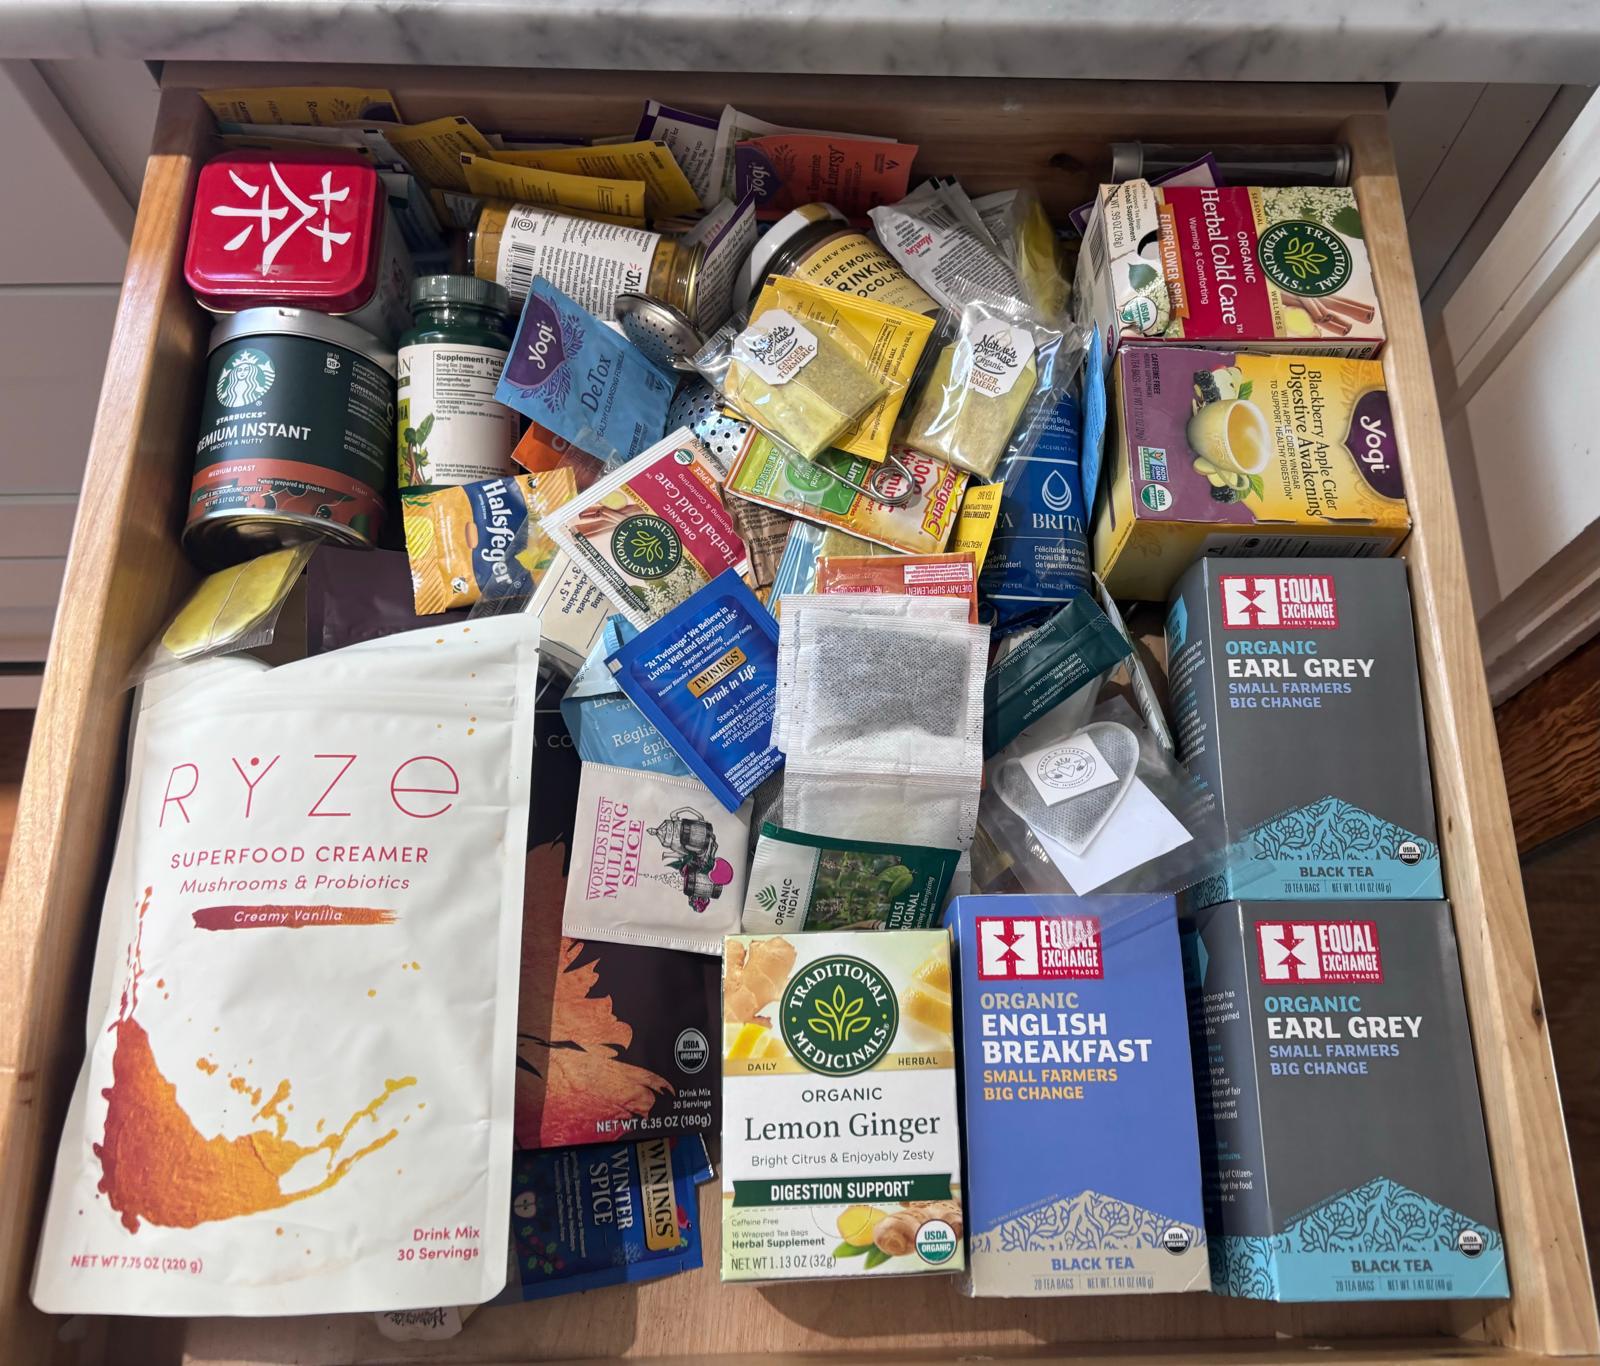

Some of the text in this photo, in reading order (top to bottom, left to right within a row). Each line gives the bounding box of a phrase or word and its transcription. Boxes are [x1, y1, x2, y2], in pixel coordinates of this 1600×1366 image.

[211, 161, 351, 276] 茶
[1251, 192, 1262, 225] SEASONAL
[1125, 203, 1137, 242] Supplement
[822, 250, 839, 264] NEW
[1159, 213, 1184, 309] ELDERFLOWER SPICE
[1200, 188, 1238, 325] Herbal Cold Care
[1237, 231, 1256, 284] ORGANIC
[1196, 259, 1209, 304] Comforting
[1270, 290, 1282, 331] WELLNESS
[528, 321, 557, 370] yogi
[436, 353, 484, 364] Supplement
[777, 345, 806, 371] GINGER
[777, 345, 815, 379] TURMERIC
[581, 355, 612, 413] DeTox
[216, 411, 264, 426] STARBUCKS
[241, 423, 311, 440] INSTANT
[241, 438, 264, 446] NUTTY
[1275, 426, 1285, 456] HEALTHY
[1288, 363, 1322, 517] Digestive Awakening
[1308, 370, 1337, 511] Blackberry Apple Cider
[1359, 415, 1386, 474] yogi
[1290, 455, 1300, 490] VINEGAR
[275, 480, 297, 489] prepared
[928, 467, 959, 535] mergen-C
[655, 472, 737, 565] Herbal Cold Care
[663, 504, 696, 540] ORGANIC
[1032, 513, 1083, 534] BRITA
[481, 479, 515, 584] Halsfeger
[576, 584, 597, 614] Sachets
[904, 584, 971, 594] DIETARY SUPPLEMENT
[1280, 578, 1333, 603] EQUAL
[698, 612, 722, 630] Believe
[1281, 603, 1335, 619] EXCHANGE
[648, 622, 725, 681] Living Enjoying
[1225, 640, 1317, 655] ORGANIC
[692, 651, 739, 690] TWININGS
[1227, 659, 1375, 678] EARL GREY
[702, 664, 756, 710] Drink Life
[744, 683, 768, 702] minutes.
[1229, 682, 1352, 694] SMALL FARMERS
[1230, 697, 1322, 709] BIG CHANGE
[612, 725, 656, 747] Réglis
[170, 846, 429, 869] SUPERFOOD CREAMER
[589, 797, 614, 900] WORLDS BEST
[603, 803, 629, 900] MULLING
[622, 820, 642, 887] SPICE
[1300, 867, 1374, 877] BLACK TEA
[179, 874, 410, 895] Mushrooms & Probiotics
[775, 879, 793, 926] ORGANIC
[786, 888, 800, 918] INDIA
[901, 892, 920, 930] RIGINAL
[233, 909, 343, 924] Creamy Vanilla
[889, 902, 905, 930] TULSI
[1040, 919, 1097, 949] EQUAL
[1320, 925, 1376, 953] EQUAL
[1042, 949, 1098, 968] EXCHANGE
[1322, 953, 1379, 972] EXCHANGE
[789, 964, 890, 1008] TRADITIONAL
[981, 993, 1079, 1009] ORGANIC
[1264, 996, 1362, 1013] ORGANIC
[982, 1013, 1107, 1036] ENGLISH
[1267, 1016, 1423, 1039] EARL GREY
[680, 1051, 702, 1060] ORGANIC
[683, 1041, 700, 1049] USDA
[792, 1027, 887, 1068] MEDICINALS
[982, 1039, 1152, 1064] BREAKFAST
[1269, 1044, 1400, 1058] SMALL FARMERS
[747, 1056, 938, 1072] DAILY HERBAL
[1270, 1062, 1368, 1075] BIG CHANGE
[983, 1069, 1118, 1083] SMALL FARMERS
[679, 1089, 711, 1098] Drink Mix
[801, 1088, 883, 1103] ORGANIC
[984, 1086, 1084, 1100] BIG CHANGE
[683, 1099, 712, 1110] Servings
[597, 1114, 712, 1133] NET WT 6.35 OZ (180g)
[744, 1113, 941, 1142] Lemon Ginger
[751, 1149, 935, 1168] Bright Citrus & Enjoyably Zesty
[589, 1162, 614, 1226] SPICE
[610, 1148, 633, 1230] WINTER
[650, 1138, 674, 1238] WININGS
[770, 1183, 843, 1201] DIGESTION
[412, 1226, 480, 1242] Drink Mix
[732, 1237, 825, 1250] Herbal Supplement
[924, 1230, 948, 1240] USDA
[397, 1246, 479, 1262] 30 Servings
[922, 1243, 951, 1252] ORGANIC
[70, 1254, 203, 1275] NET WT 7.75 OZ (220 g)
[731, 1254, 837, 1271] NET WT 1.13 OZ (32g)
[1051, 1257, 1135, 1271] BLACK TEA
[1352, 1260, 1433, 1273] BLACK TEA
